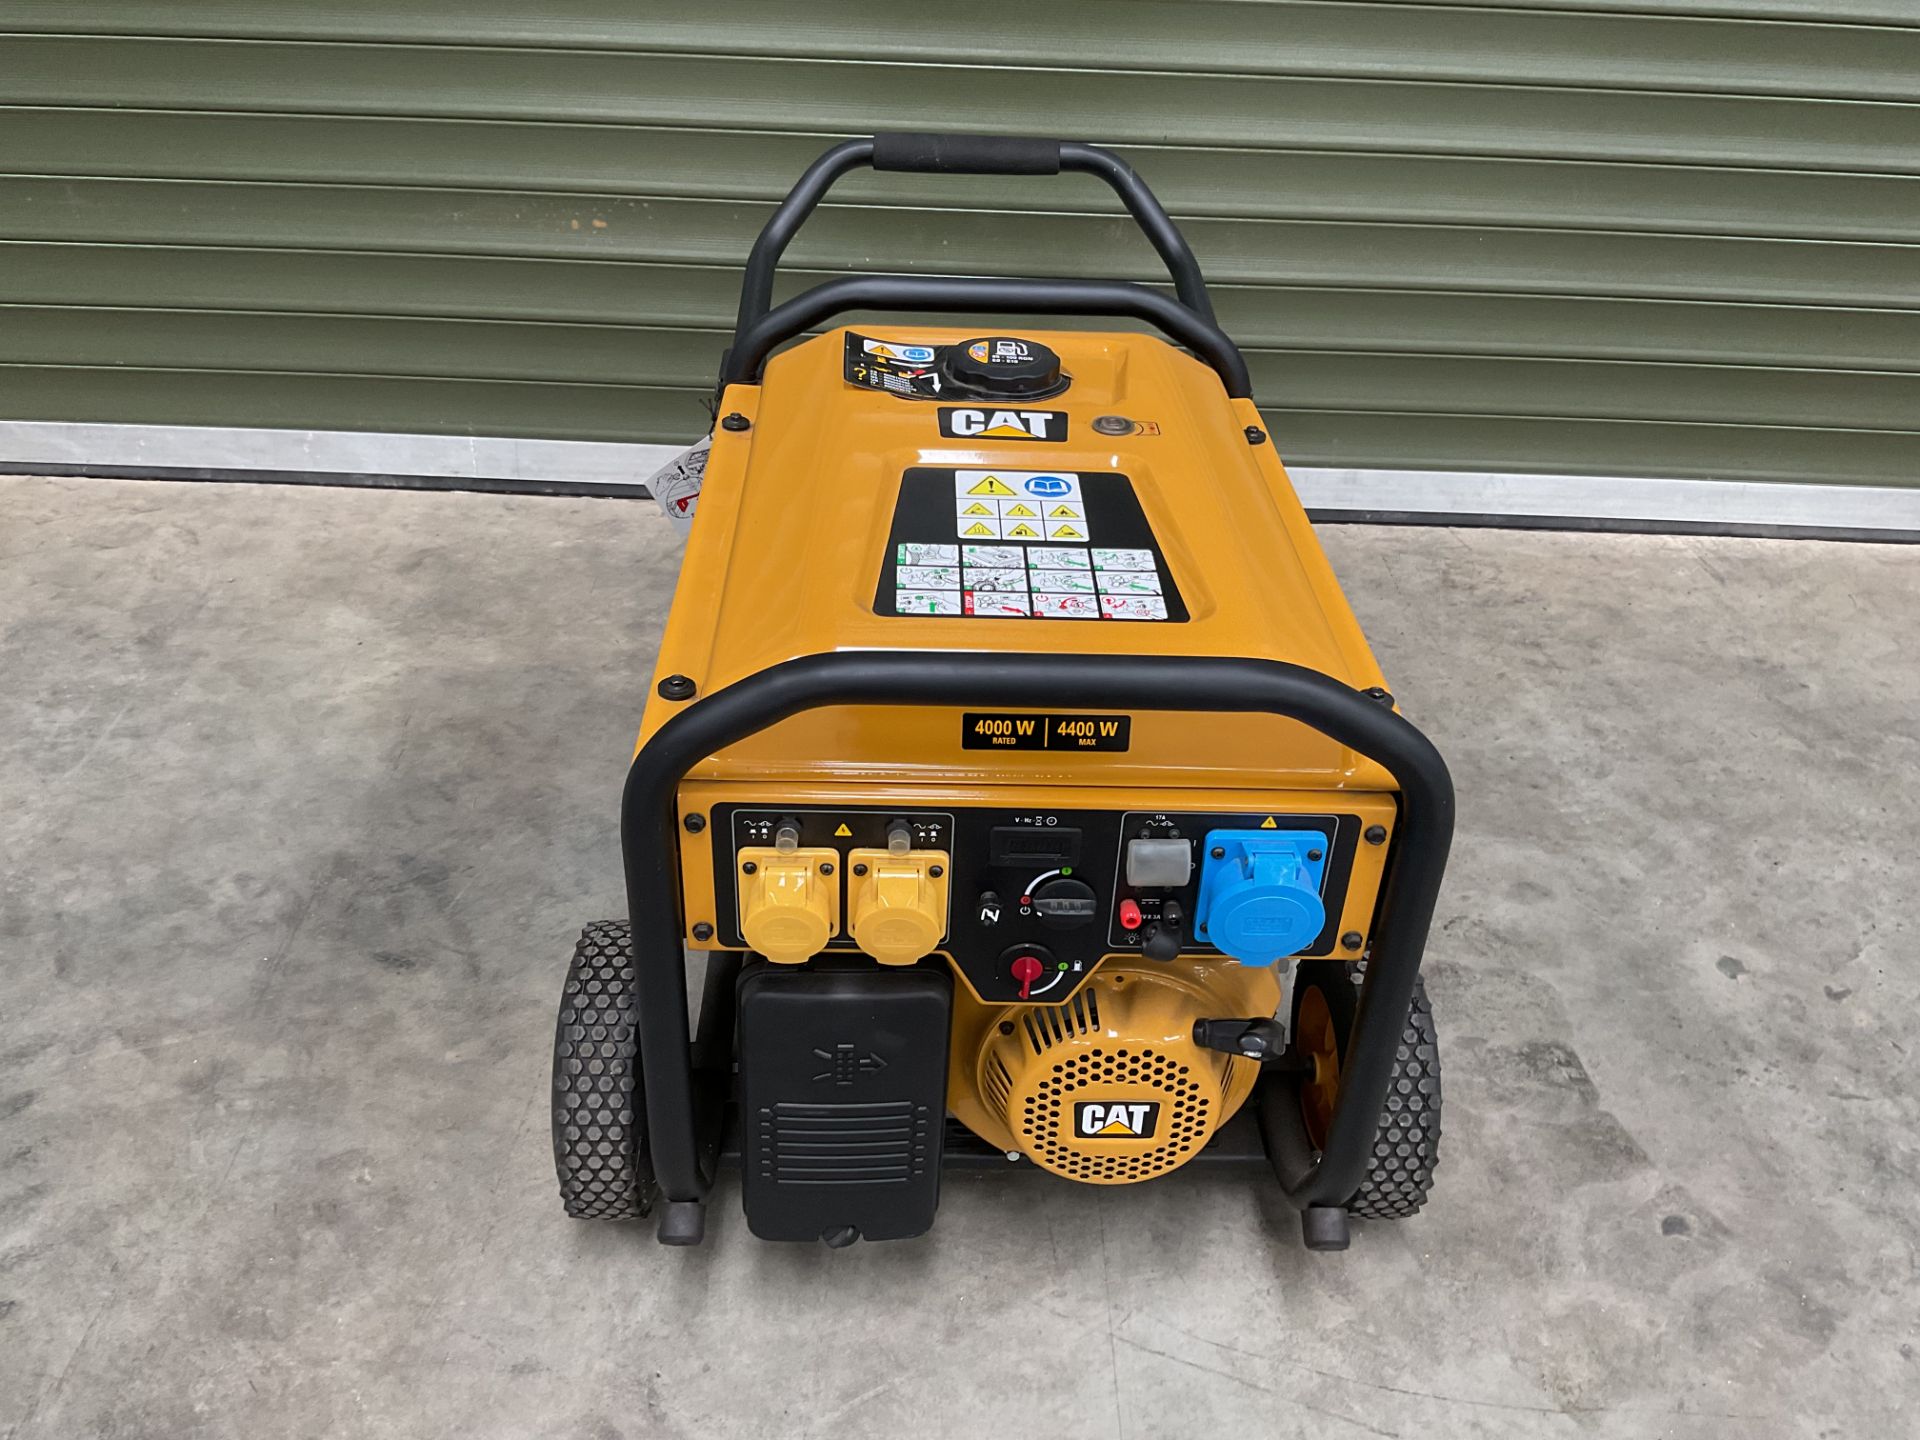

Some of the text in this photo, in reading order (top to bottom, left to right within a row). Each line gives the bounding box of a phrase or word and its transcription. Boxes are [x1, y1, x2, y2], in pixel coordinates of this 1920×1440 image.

[951, 409, 1053, 438] CAT
[974, 719, 1035, 736] 4000 W
[1057, 721, 1118, 737] 4400 W
[992, 737, 1016, 745] RATED
[1078, 738, 1096, 746] MAX
[1082, 1104, 1150, 1135] CAT
